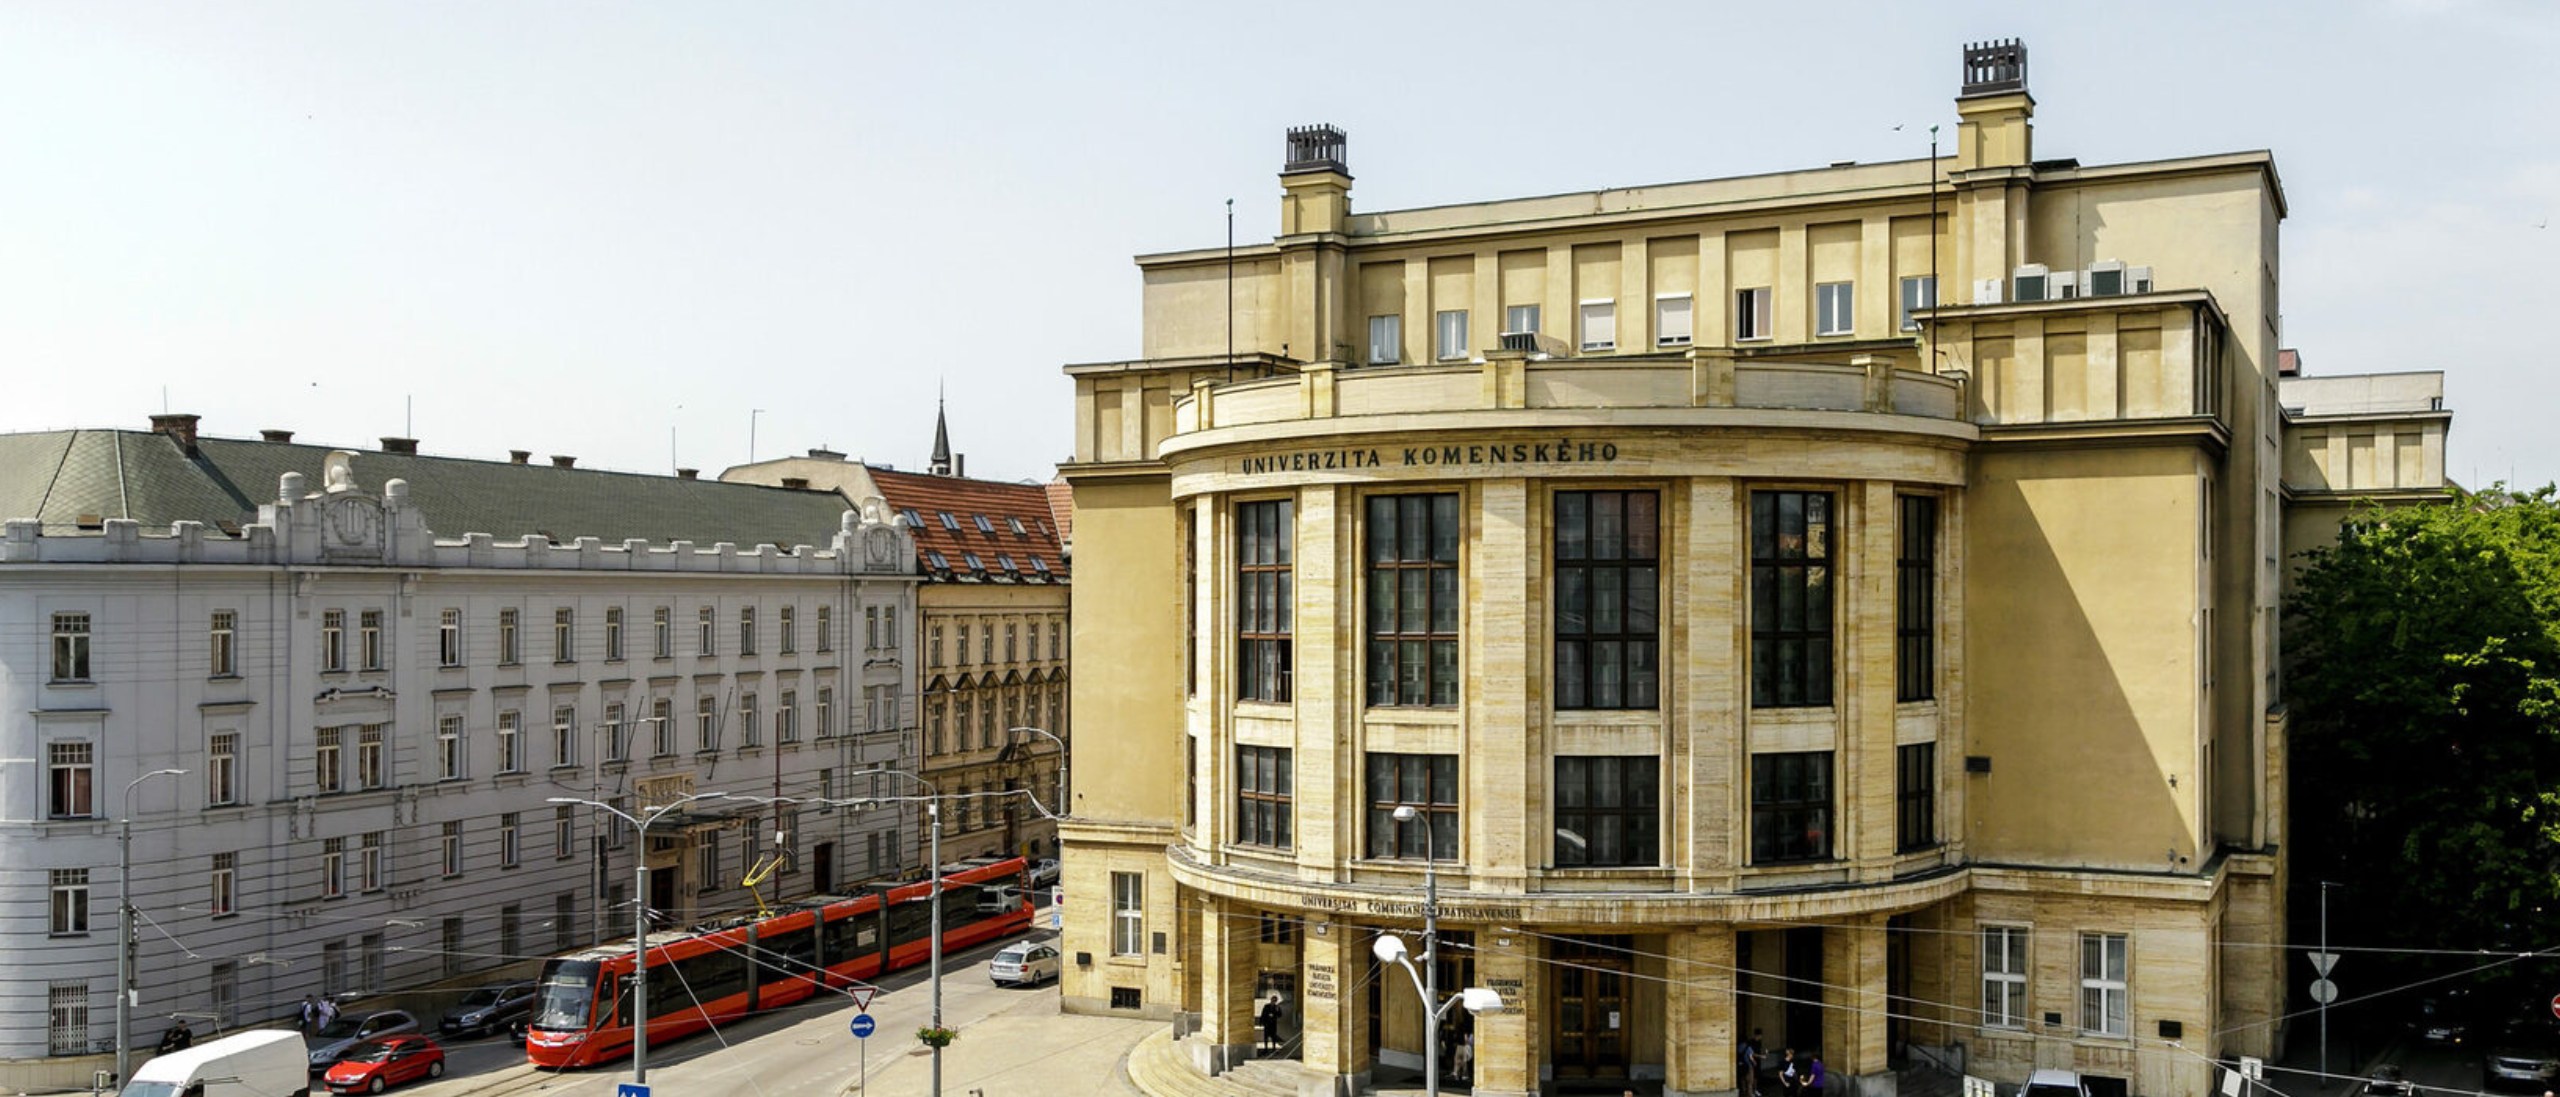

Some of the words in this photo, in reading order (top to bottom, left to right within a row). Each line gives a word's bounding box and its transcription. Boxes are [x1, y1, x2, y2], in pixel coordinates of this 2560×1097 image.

[1242, 449, 1381, 475] UNIVERZITA
[1403, 437, 1618, 466] KOMENSKÉHO
[1301, 896, 1358, 912] UNIVERSITAS
